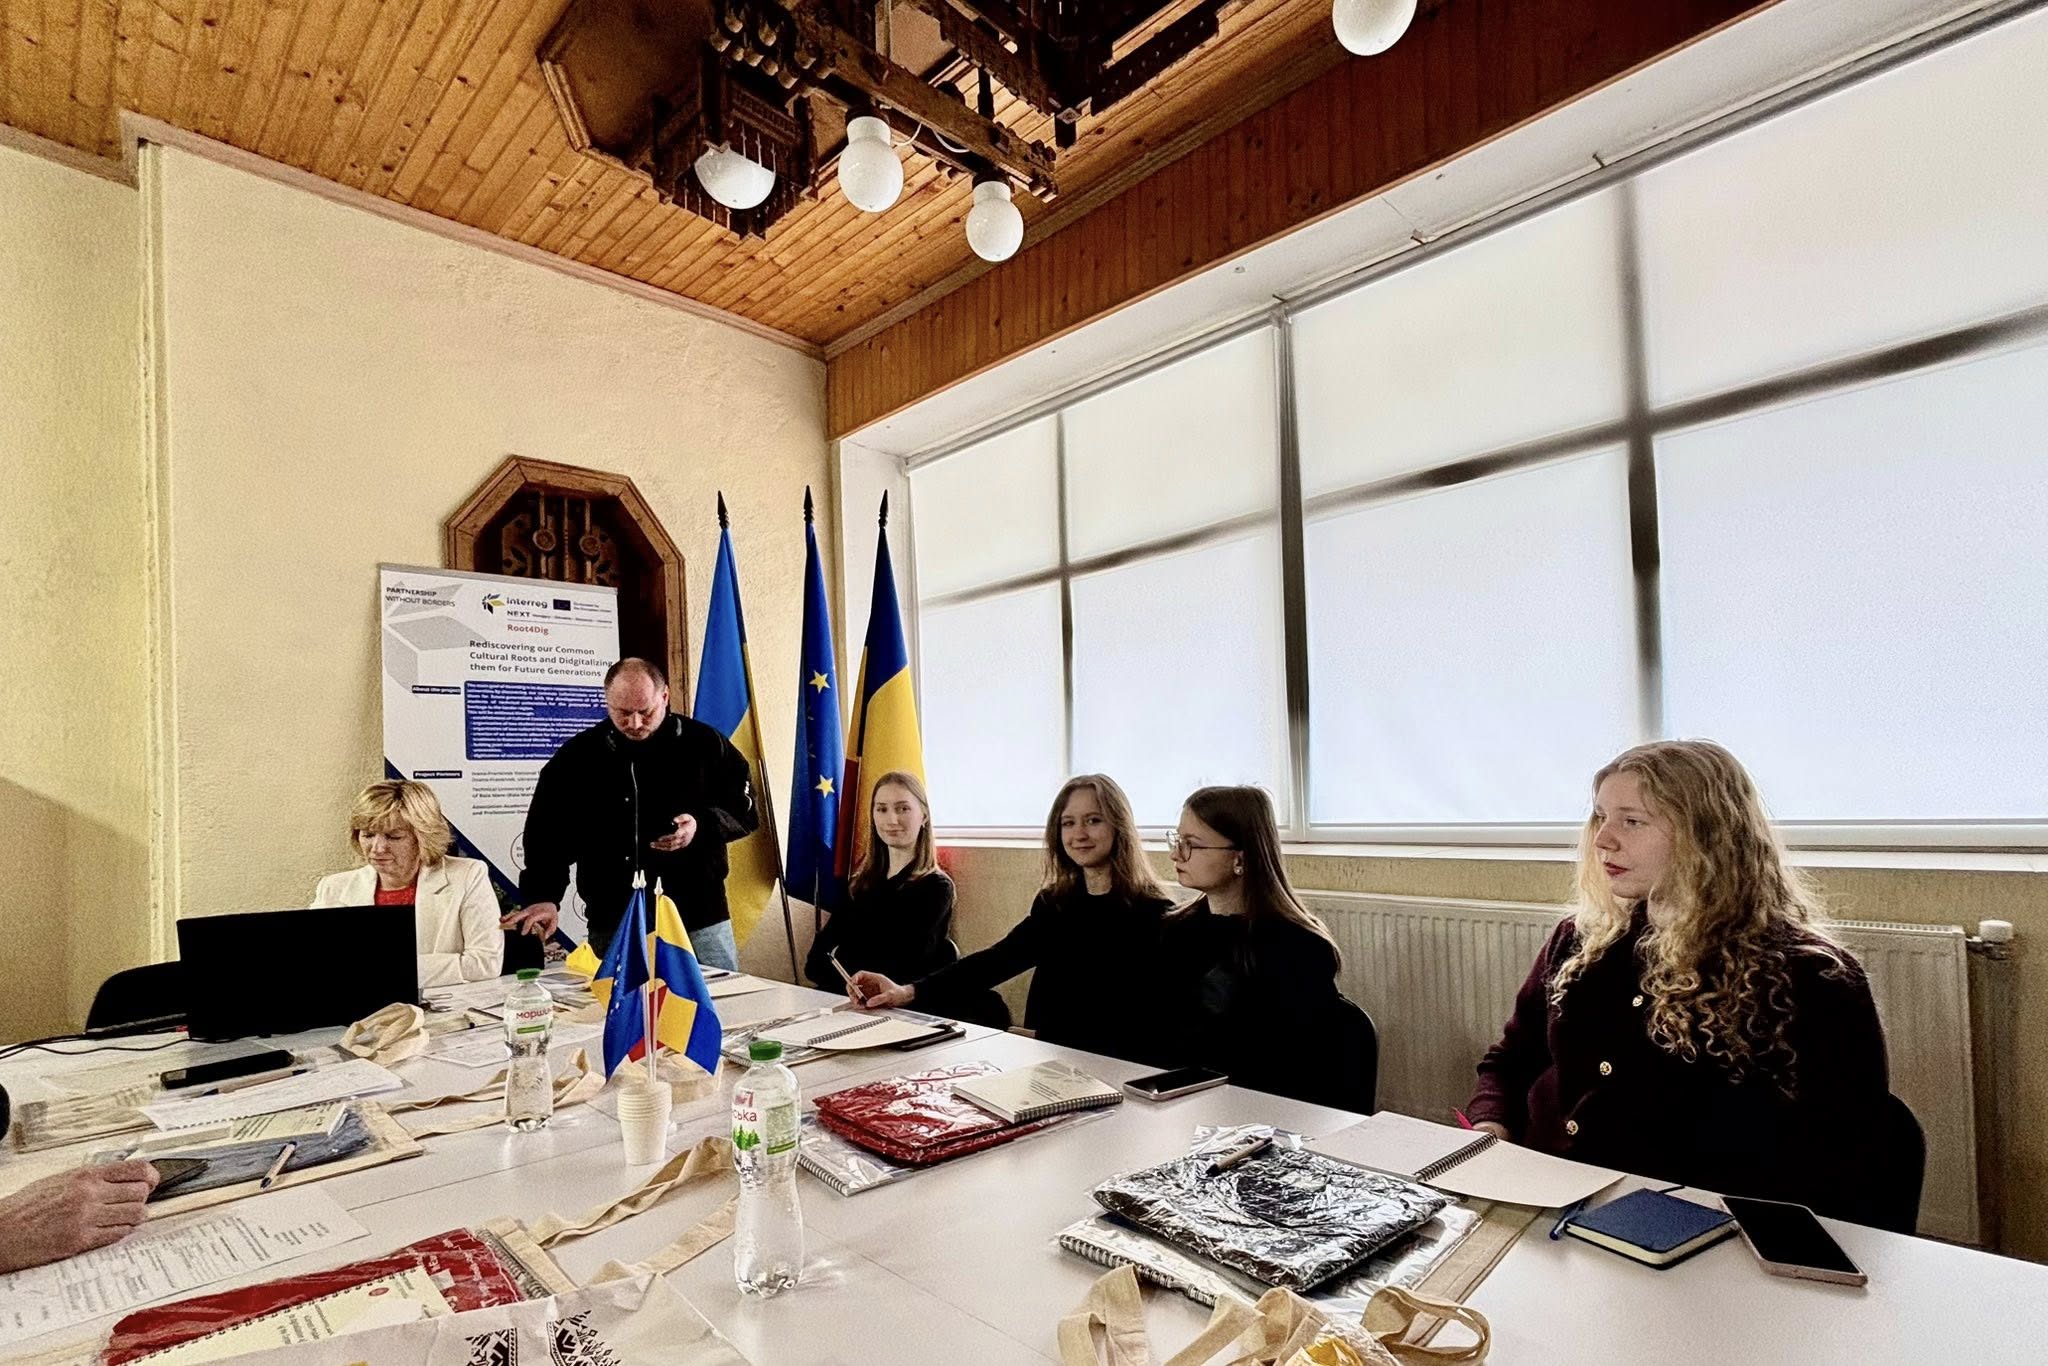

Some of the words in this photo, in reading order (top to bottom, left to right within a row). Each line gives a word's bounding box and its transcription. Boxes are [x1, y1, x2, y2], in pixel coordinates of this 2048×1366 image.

[386, 587, 437, 596] PARTNERSHIP
[385, 595, 420, 604] WITHOUT
[422, 599, 456, 607] BORDERS
[507, 610, 531, 618] NEXT
[507, 624, 549, 635] Root4Dig
[469, 640, 535, 653] Rediscovering
[555, 646, 595, 655] Common
[469, 652, 509, 661] Cultural
[511, 655, 537, 663] Roots
[539, 656, 556, 664] and
[559, 658, 613, 668] Didgitalizing
[470, 663, 496, 671] them
[498, 664, 512, 672] for
[514, 665, 545, 674] Future
[547, 667, 602, 677] Generations
